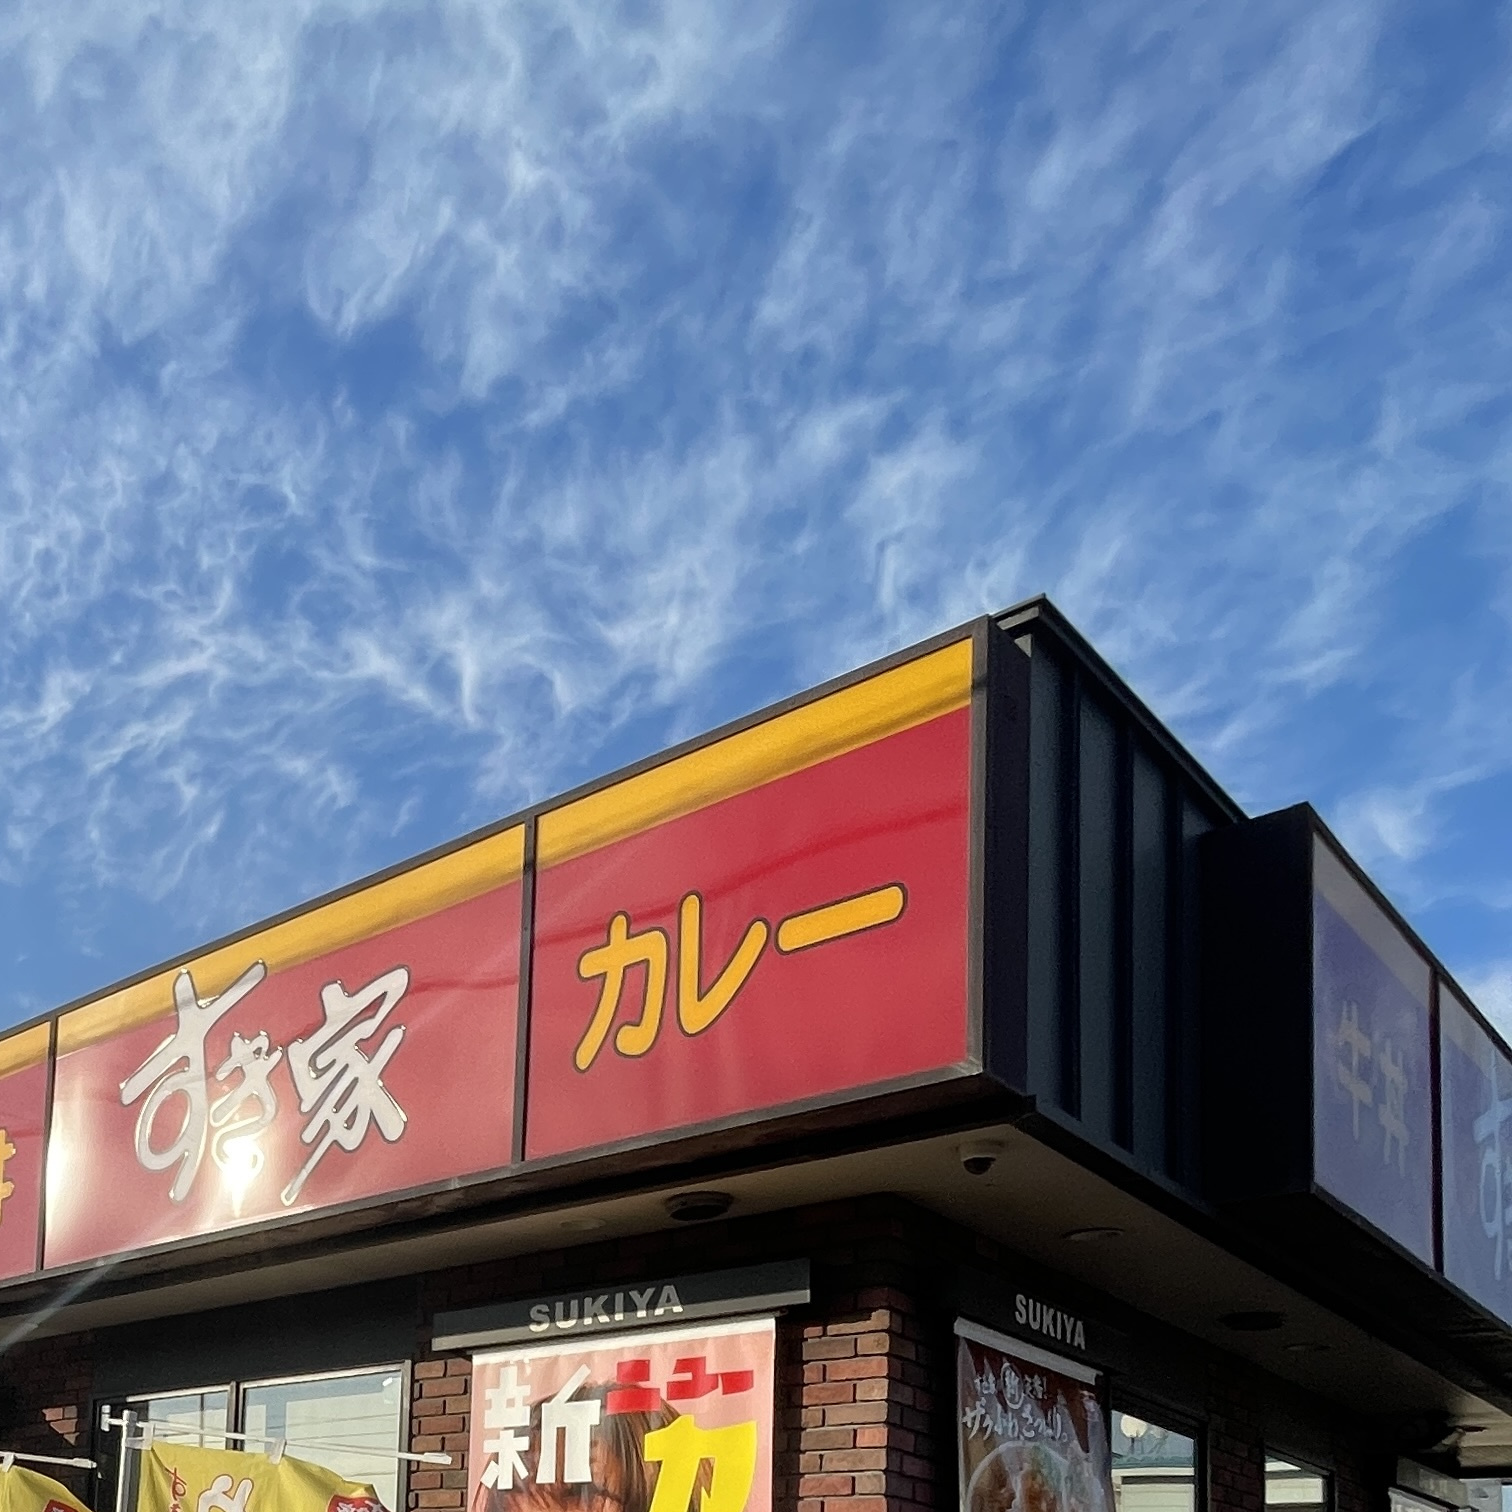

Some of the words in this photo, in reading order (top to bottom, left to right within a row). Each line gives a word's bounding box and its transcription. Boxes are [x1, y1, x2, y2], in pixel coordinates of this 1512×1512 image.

[573, 882, 907, 1071] カレー
[119, 958, 412, 1205] すき家
[1338, 1000, 1410, 1180] 牛丼
[528, 1284, 684, 1333] SUKIYA
[1015, 1293, 1087, 1351] SUKIYA
[480, 1362, 603, 1491] 新
